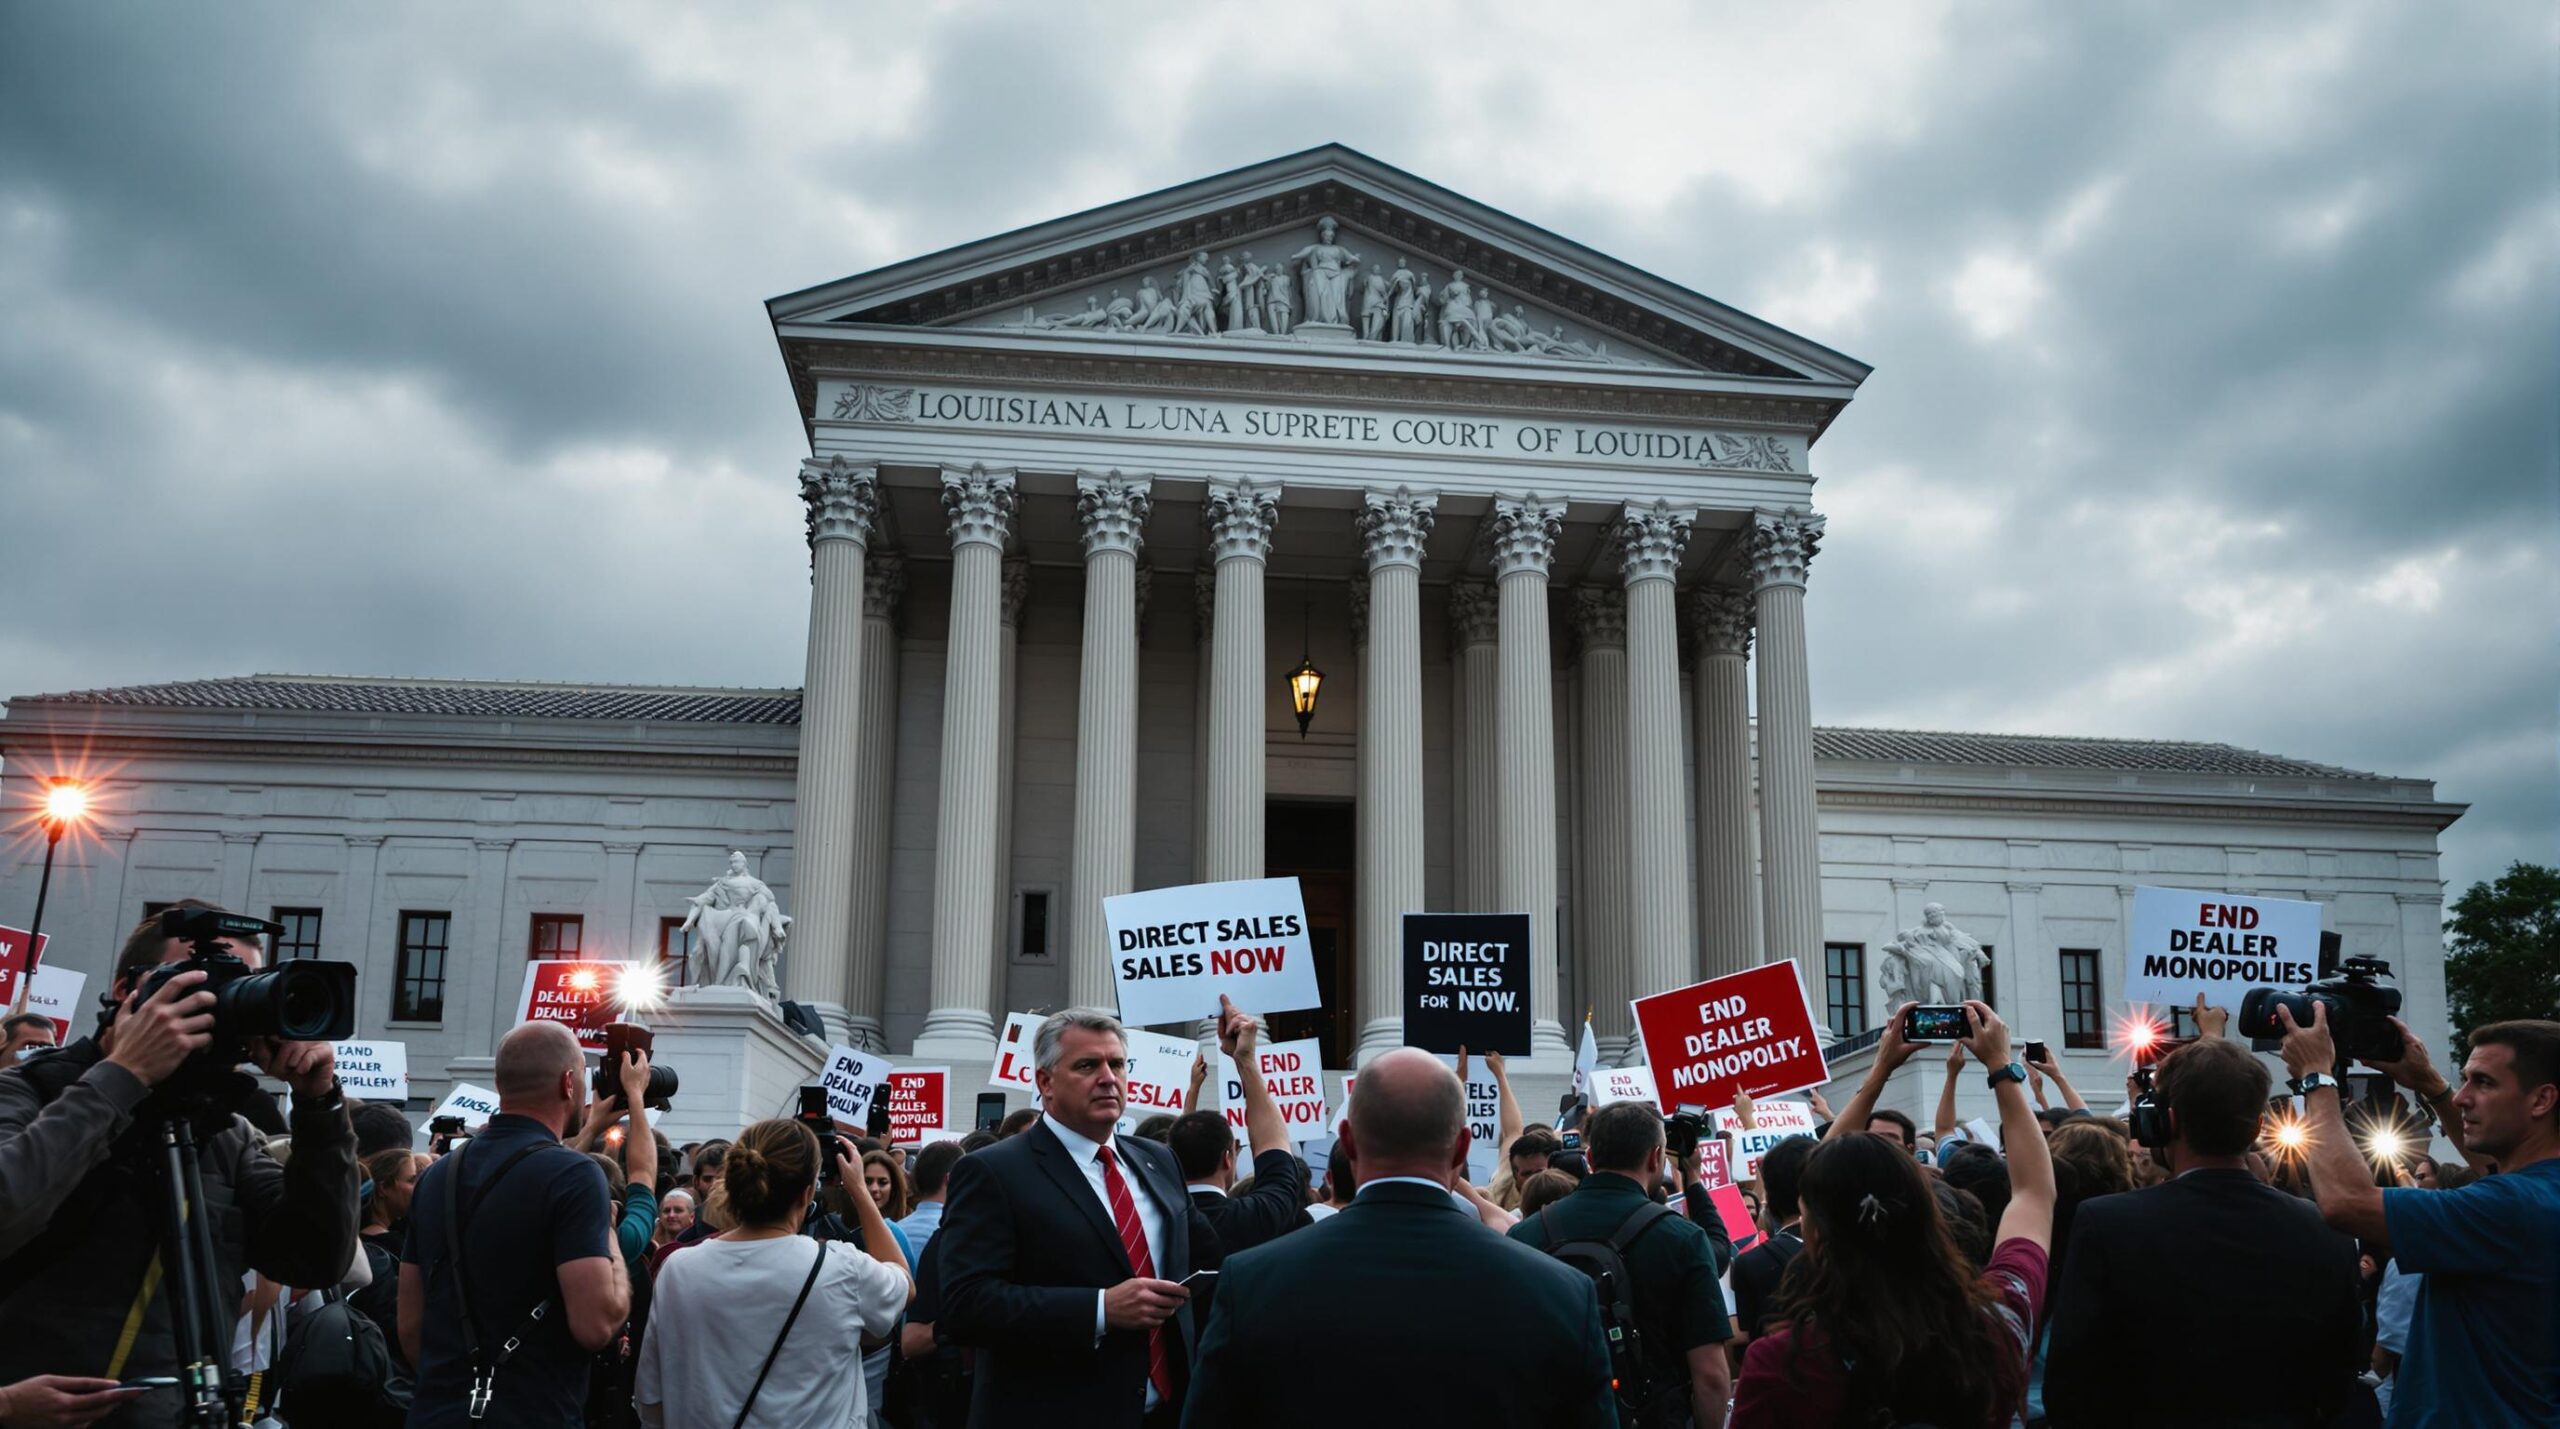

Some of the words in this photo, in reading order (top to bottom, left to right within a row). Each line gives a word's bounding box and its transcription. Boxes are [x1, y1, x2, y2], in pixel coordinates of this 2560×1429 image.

[1245, 410, 1380, 441] SUPRETE
[1393, 419, 1498, 448] COURT
[1517, 427, 1562, 453] OF
[2200, 903, 2259, 930] END
[1119, 921, 1209, 951] DIRECT
[1217, 915, 1301, 942] SALES
[2170, 929, 2278, 957] DEALER
[1122, 953, 1203, 980] SALES
[1210, 946, 1285, 975] NOW
[1423, 941, 1509, 963] DIRECT
[1428, 967, 1503, 987] SALES
[2143, 955, 2313, 984] MONOPOLIES
[1420, 994, 1449, 1008] FOR
[1699, 995, 1747, 1024] END
[1684, 1017, 1774, 1057] DEALER
[835, 1056, 863, 1077] END
[1260, 1053, 1301, 1074] END
[823, 1072, 871, 1102] DEALER
[901, 1078, 925, 1088] END
[1126, 1082, 1183, 1109] ESLA
[1227, 1077, 1315, 1100] DALER
[1465, 1082, 1498, 1100] ELS
